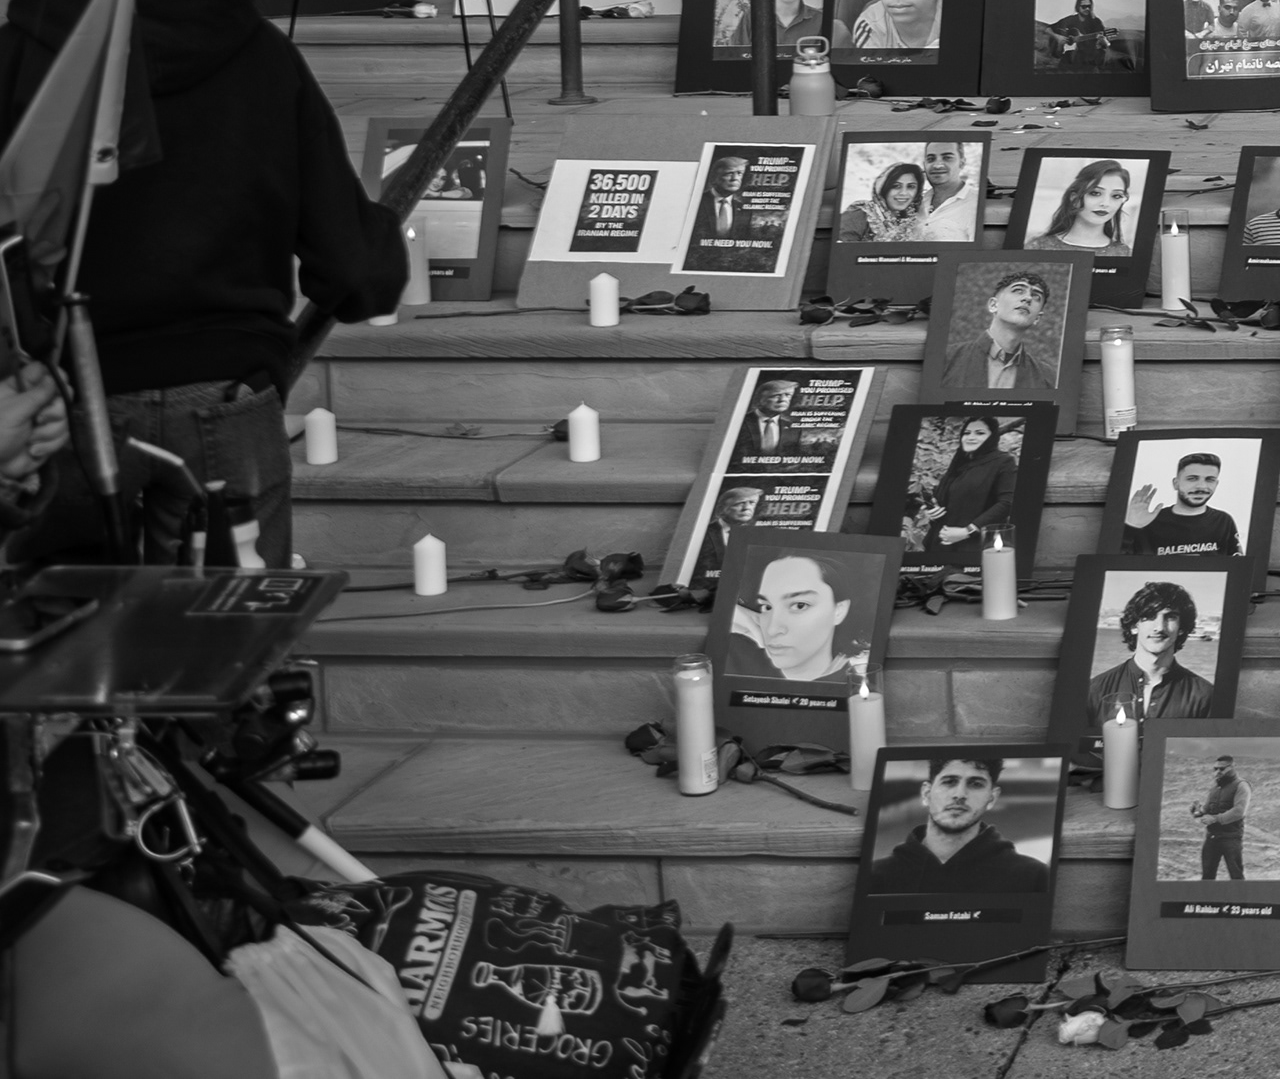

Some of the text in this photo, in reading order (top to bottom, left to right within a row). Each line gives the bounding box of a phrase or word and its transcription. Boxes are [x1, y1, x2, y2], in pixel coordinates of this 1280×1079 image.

[1206, 60, 1234, 74] تهران
[1236, 58, 1264, 73] ناتمام
[590, 173, 650, 192] 36,500
[589, 193, 644, 204] KILLED IN
[588, 205, 638, 218] 2 DAYS
[1157, 542, 1218, 556] BALENCIAGA
[1184, 905, 1194, 913] Ali
[1260, 907, 1272, 915] old
